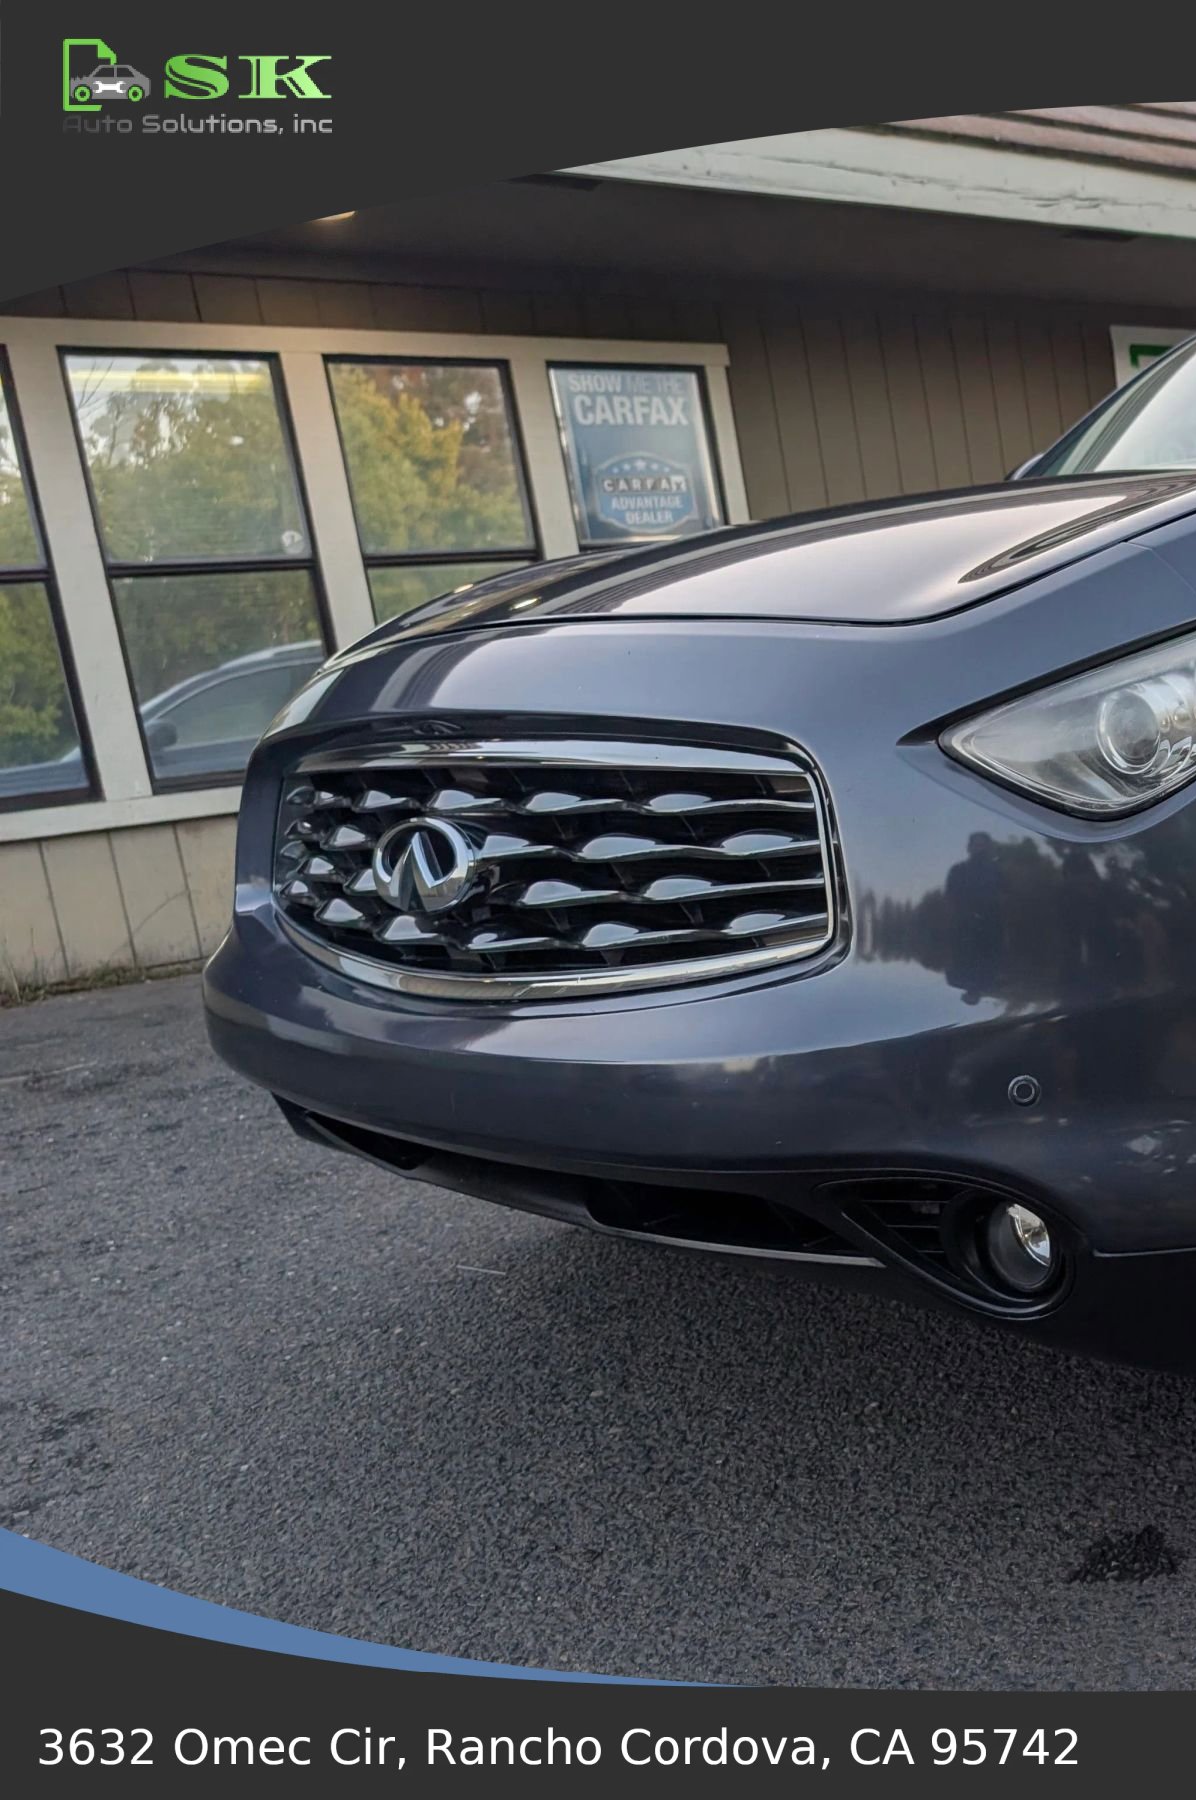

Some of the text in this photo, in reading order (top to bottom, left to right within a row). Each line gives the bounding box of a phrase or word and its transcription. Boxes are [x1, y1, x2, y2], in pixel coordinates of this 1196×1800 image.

[567, 373, 685, 395] SHOW ME THE
[573, 394, 689, 426] CARFAX
[603, 475, 687, 493] CARFAX
[611, 494, 684, 511] ADVANTAGE
[624, 510, 674, 526] DEALER
